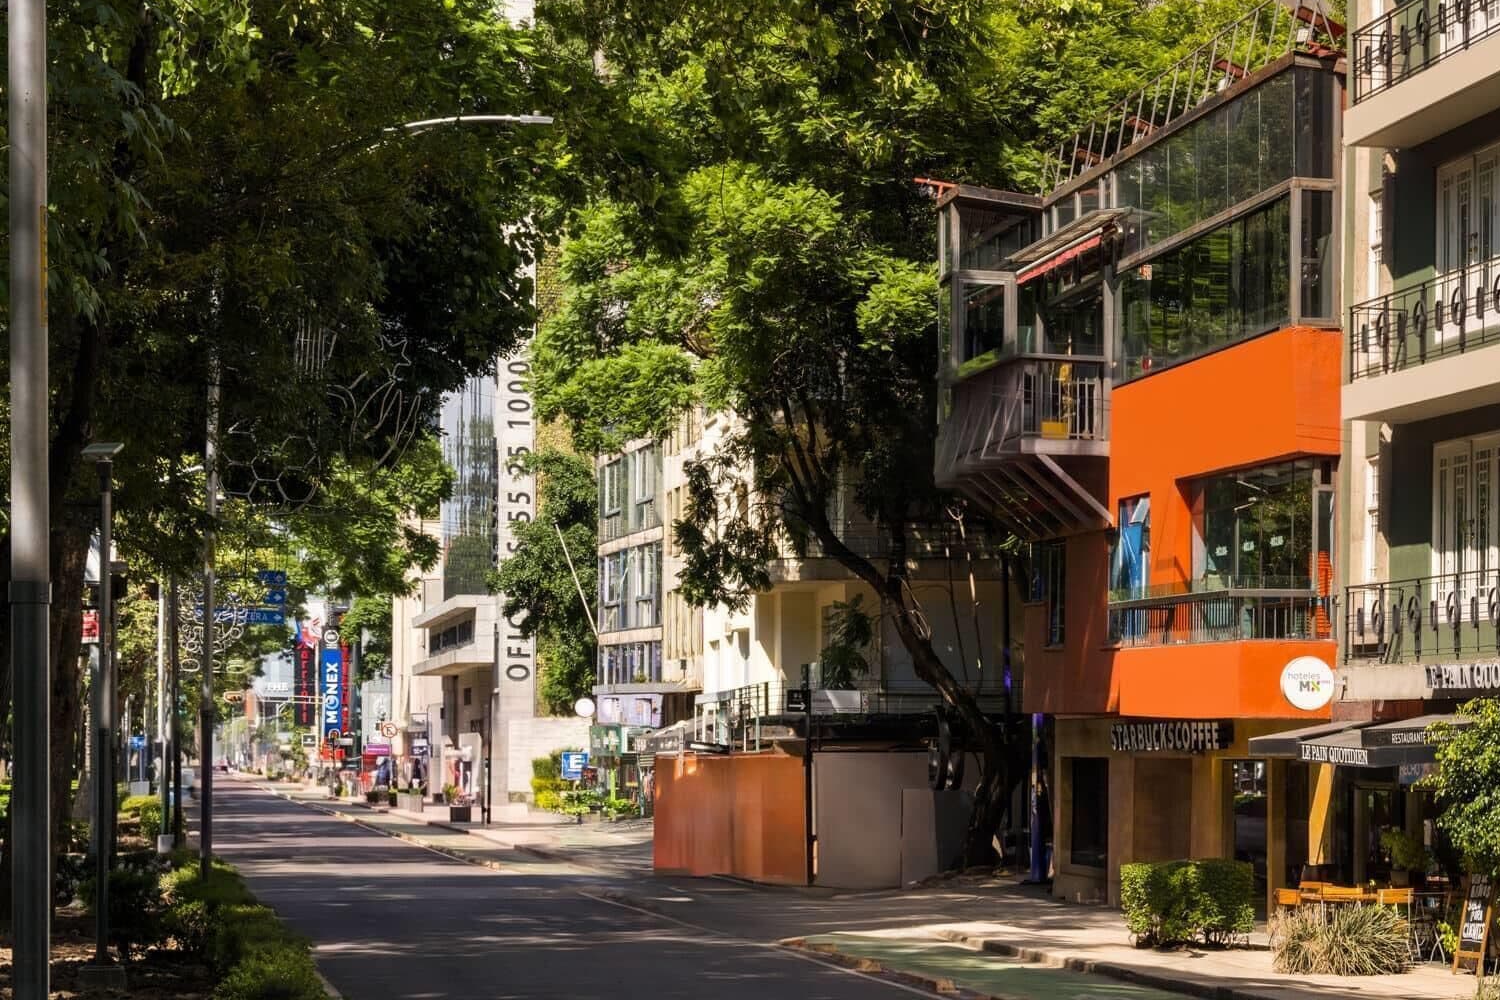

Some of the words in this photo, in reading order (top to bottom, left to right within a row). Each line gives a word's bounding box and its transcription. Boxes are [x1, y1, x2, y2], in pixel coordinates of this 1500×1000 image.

[507, 360, 531, 429] 1000
[1287, 671, 1321, 681] hoteles
[1441, 663, 1471, 689] PAIN
[326, 662, 340, 724] MONEX
[1110, 722, 1174, 751] STARBUCKS
[1175, 721, 1220, 750] COFFEE
[1391, 731, 1426, 745] RESTAURANTE
[1301, 744, 1311, 760] LE
[1311, 745, 1328, 762] PAIN
[1328, 747, 1369, 765] QUOTIDIEN
